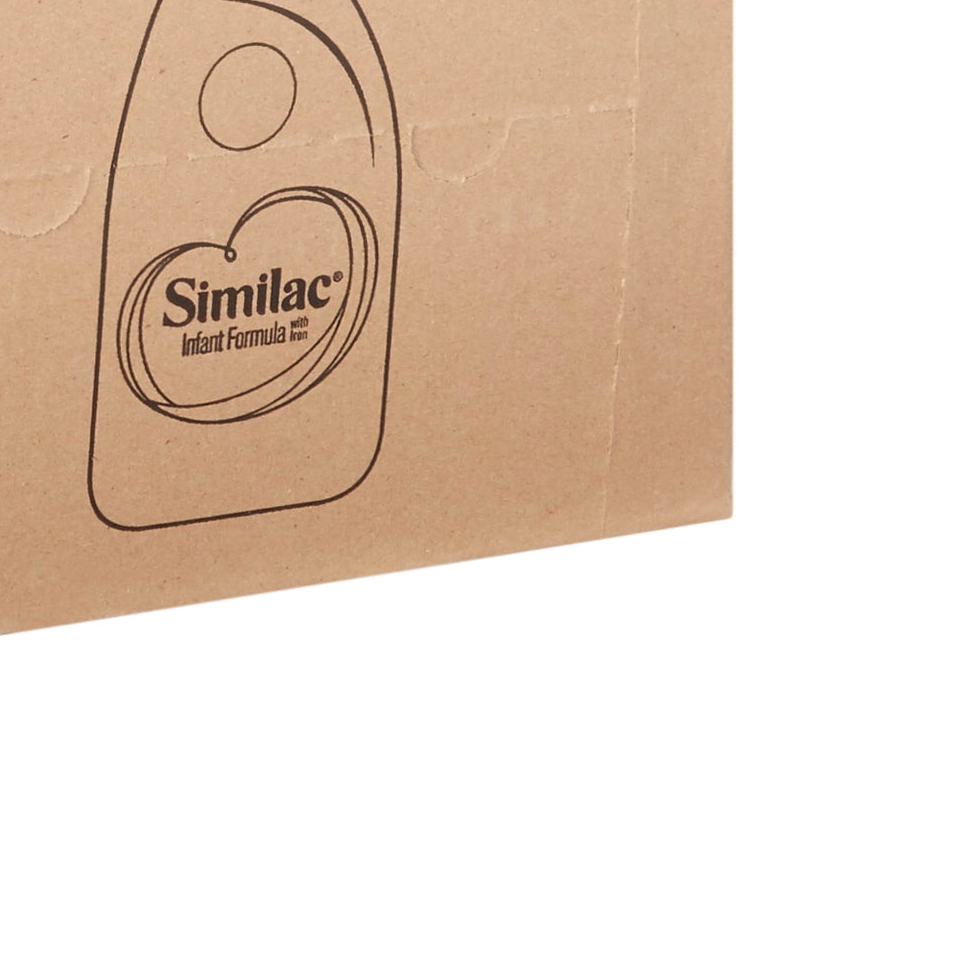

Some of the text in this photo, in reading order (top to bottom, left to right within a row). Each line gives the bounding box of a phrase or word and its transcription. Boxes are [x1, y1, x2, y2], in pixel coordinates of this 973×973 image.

[290, 316, 309, 329] with
[181, 321, 286, 357] Infant Formula
